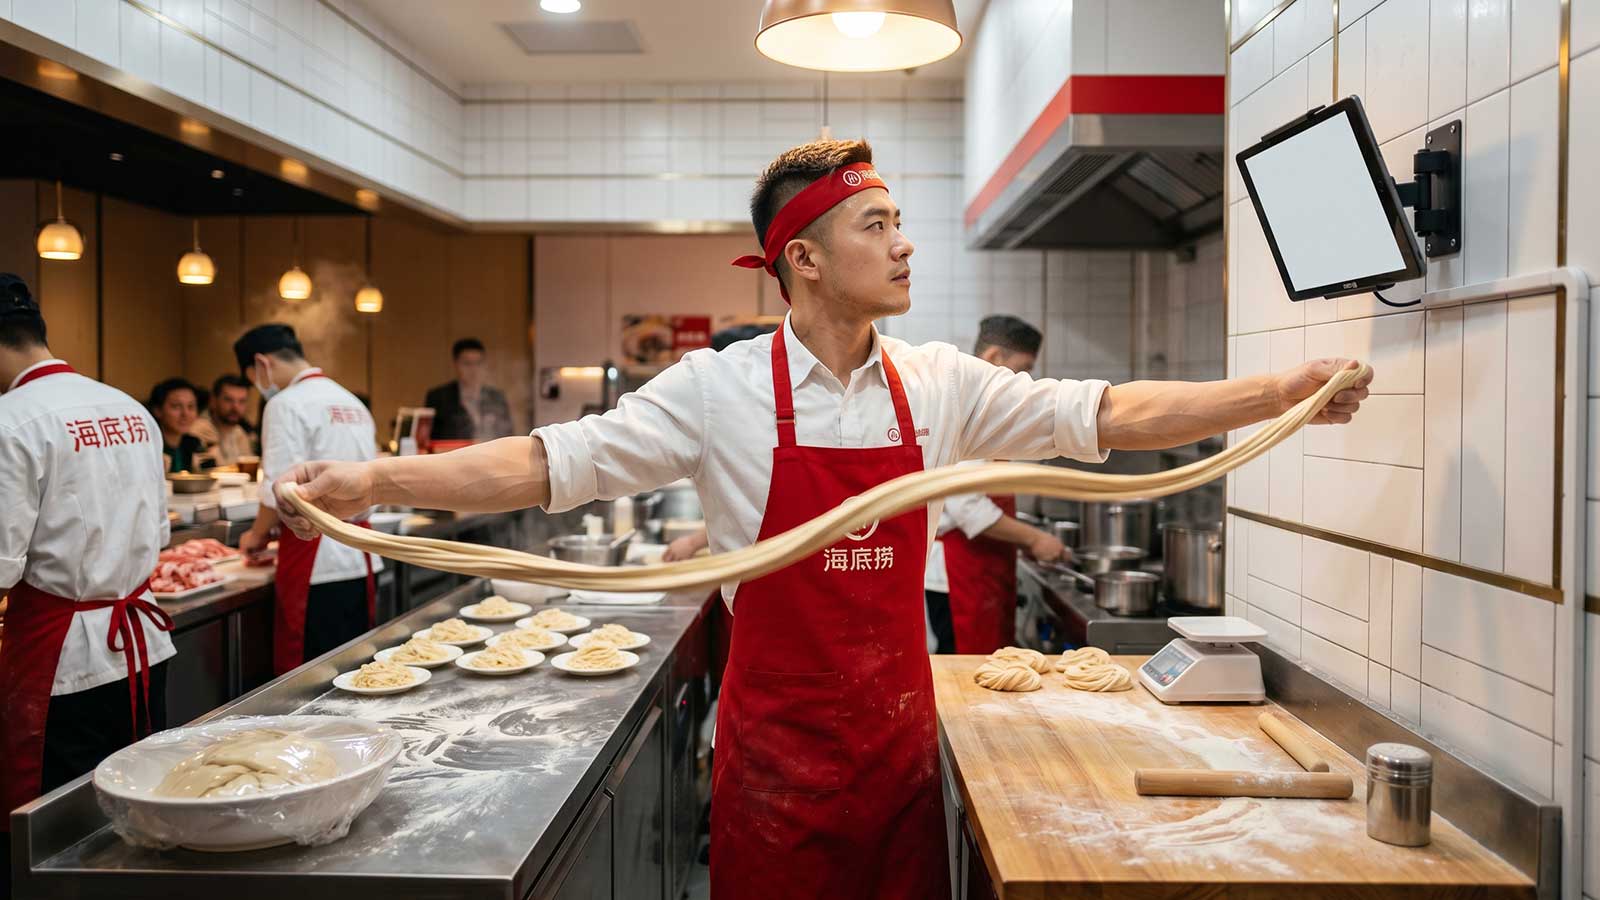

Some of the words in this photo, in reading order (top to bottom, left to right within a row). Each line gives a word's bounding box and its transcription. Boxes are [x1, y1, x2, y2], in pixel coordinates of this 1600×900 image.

[66, 416, 150, 452] 海底捞
[824, 546, 893, 572] 海底捞
